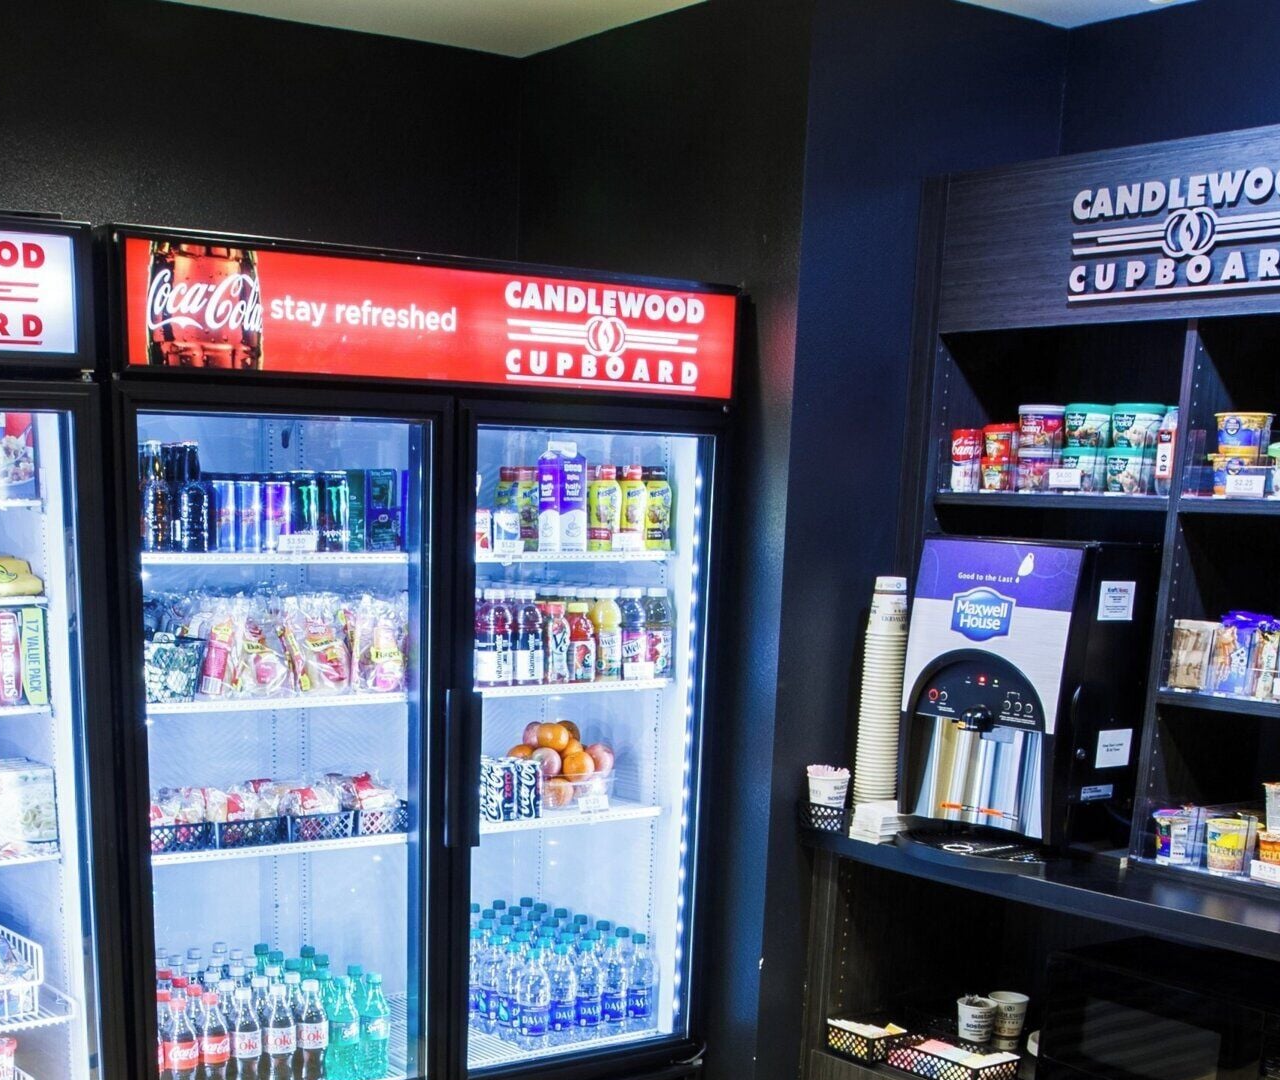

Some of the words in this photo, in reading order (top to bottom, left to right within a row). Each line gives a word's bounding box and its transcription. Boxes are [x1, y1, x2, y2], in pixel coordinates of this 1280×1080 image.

[146, 268, 264, 333] Coca-Cola
[270, 295, 328, 325] stay
[335, 298, 458, 333] refreshed
[505, 281, 706, 325] CANDLEWOOD
[506, 348, 700, 385] CUPBOARD
[958, 573, 975, 581] Good
[985, 574, 997, 582] the
[998, 575, 1013, 583] Last
[956, 599, 1009, 619] Maxwell
[959, 614, 1001, 631] House
